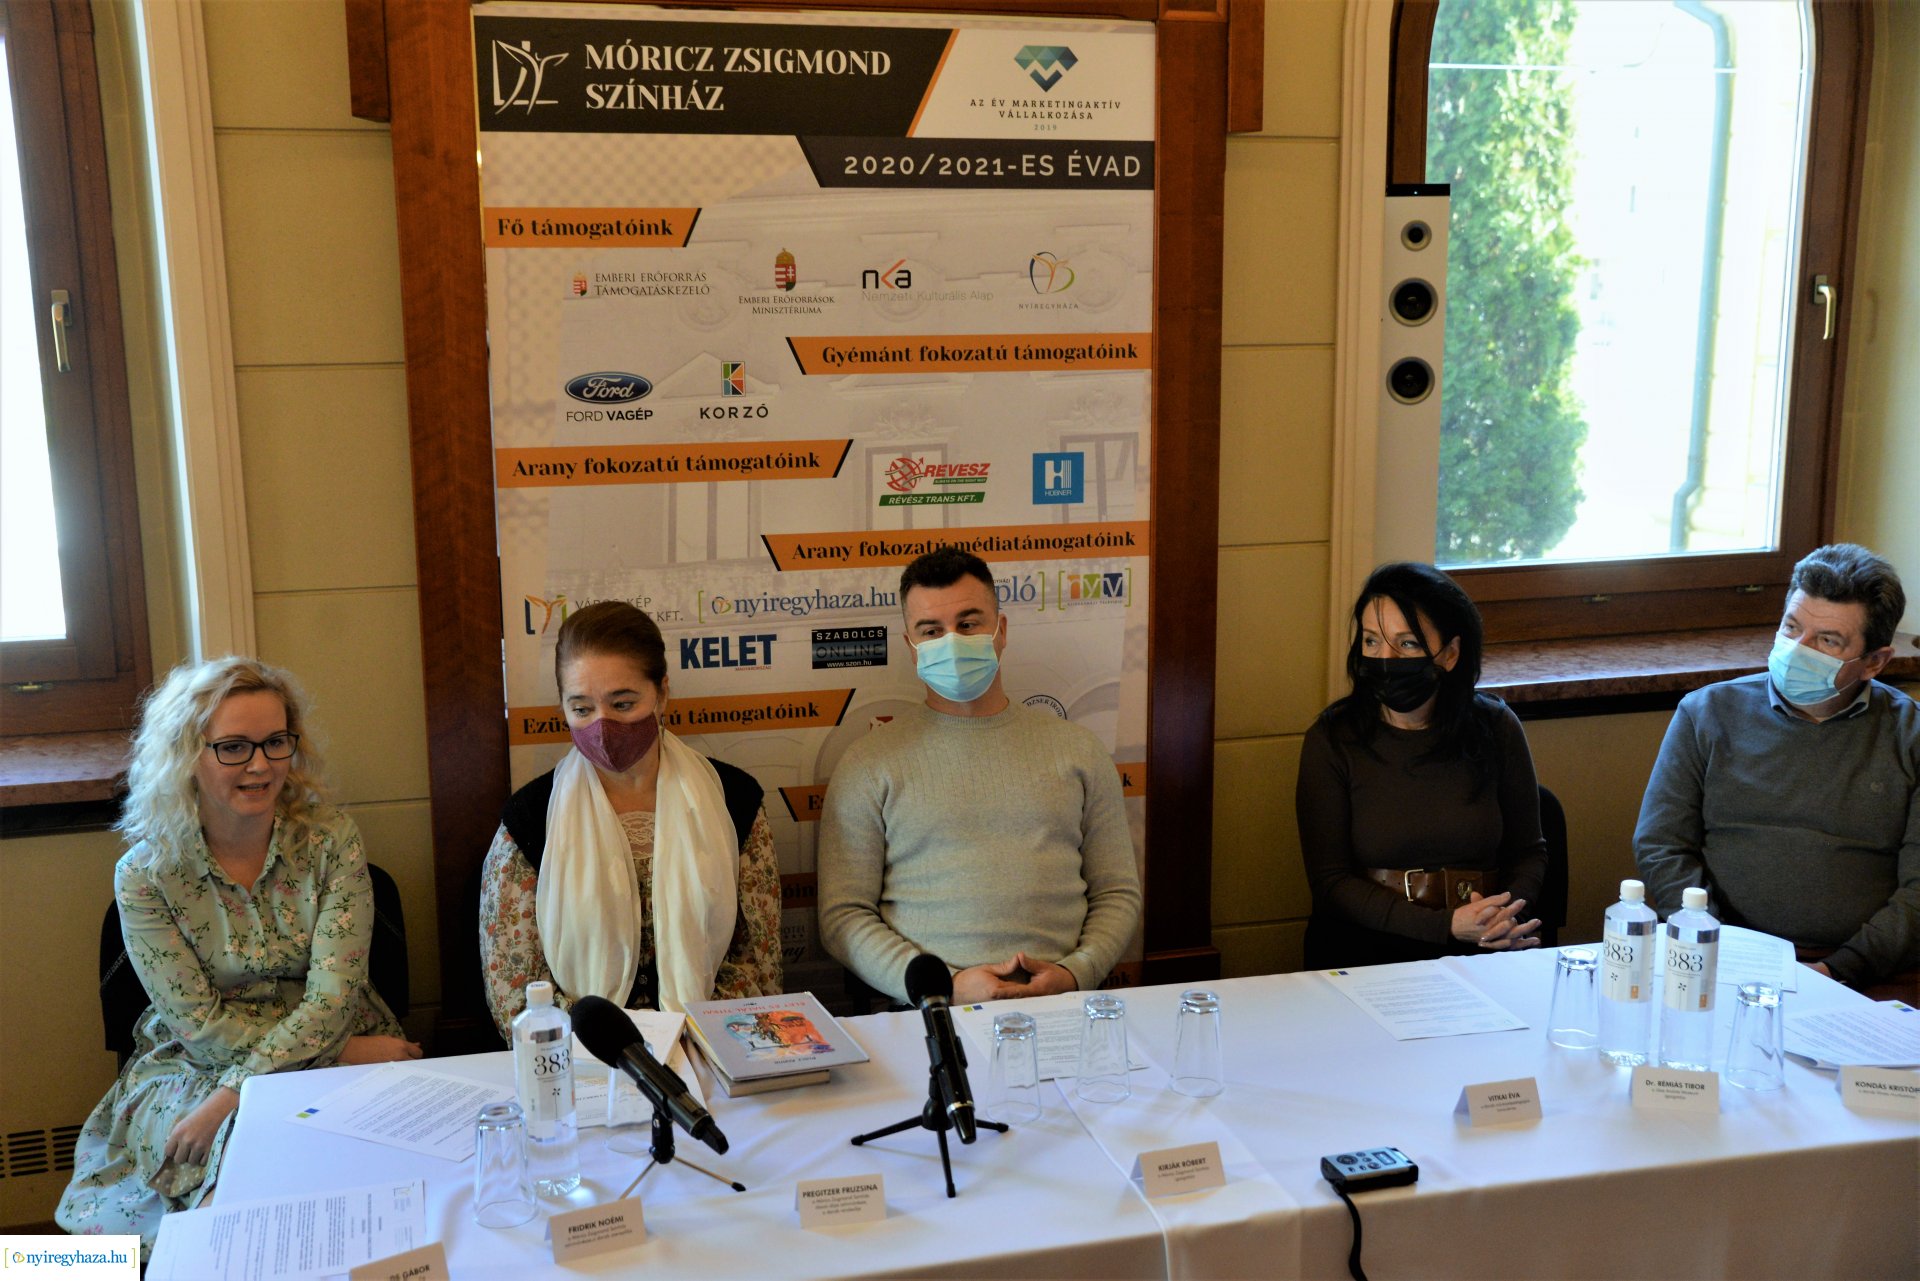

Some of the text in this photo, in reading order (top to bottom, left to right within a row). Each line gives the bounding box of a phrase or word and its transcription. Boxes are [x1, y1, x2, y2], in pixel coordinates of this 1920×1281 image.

[585, 39, 892, 76] MÓRICZ ZSIGMOND
[585, 78, 725, 111] SZÍNHÁZ
[970, 97, 1122, 110] AZ ÉV MARKETINGAKTÍV
[999, 110, 1094, 120] VÁLLALKOZÁSA
[844, 150, 1141, 177] 2020/2021-ES ÉVAD
[497, 217, 673, 240] Fő támogatóink
[595, 273, 636, 283] EMBERI
[595, 284, 710, 297] TÁMOGATÁSKEZELŐ
[861, 289, 994, 303] Nemzeti Kulturális Alap
[822, 343, 1138, 367] Gyémánt fokozatú támogatóink
[582, 376, 636, 400] Ford
[566, 408, 653, 423] FORD VAGÉP
[700, 404, 769, 420] KORZÓ
[512, 451, 820, 481] Arany fokozatú támogatóink
[888, 492, 977, 505] RÉVÉSZ TRANS KFT.
[792, 531, 1136, 562] Arany fokozatú médiatámogatóink
[734, 586, 897, 618] nyiregyhaza.hu
[995, 575, 1037, 610] pló
[657, 610, 684, 623] KFT.
[816, 628, 884, 641] SZABOLCS
[680, 634, 777, 670] KELET
[816, 641, 884, 660] ONLINE
[826, 659, 872, 668] www.szon.hu
[523, 715, 570, 735] Ezüs
[688, 702, 820, 726] támogatóink
[1667, 948, 1703, 973] 383
[534, 1048, 571, 1077] 383
[1508, 1091, 1521, 1099] ÉVA
[802, 1187, 841, 1199] PREGITZER
[841, 1182, 878, 1195] FRUZSINA
[568, 1222, 597, 1235] FRIDRIK
[598, 1214, 624, 1228] NOÉMI
